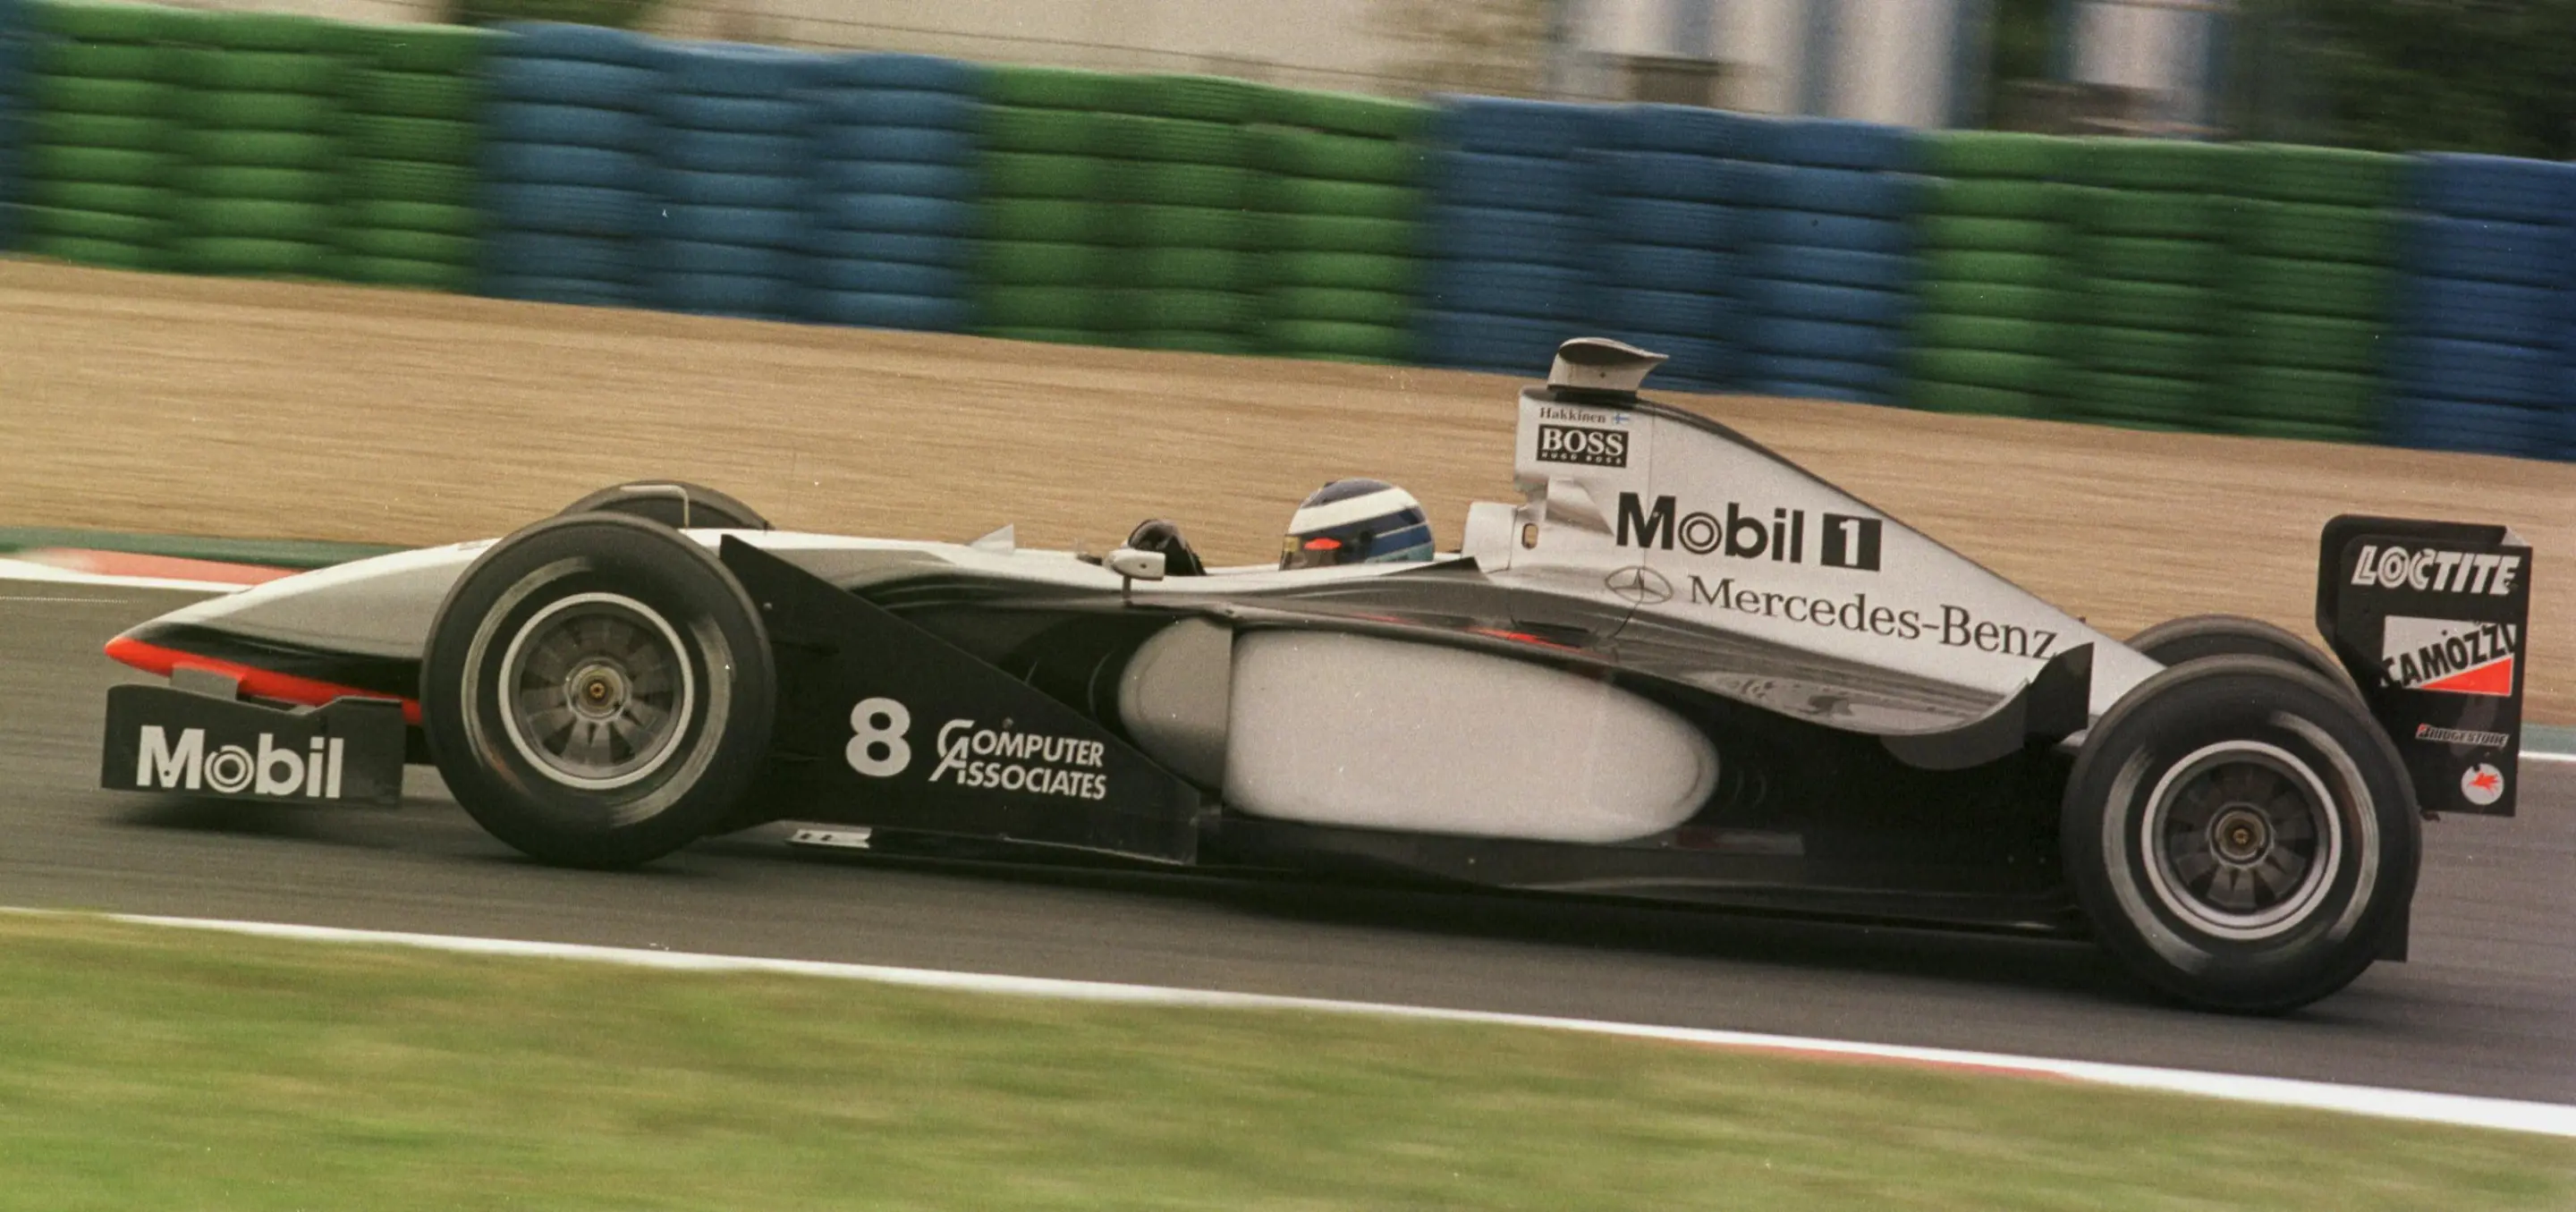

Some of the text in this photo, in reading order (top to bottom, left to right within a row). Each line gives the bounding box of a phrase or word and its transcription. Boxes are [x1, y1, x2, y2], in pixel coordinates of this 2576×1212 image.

[1542, 427, 1623, 456] BOSS
[1615, 492, 1862, 567] Mobil 1
[2351, 545, 2521, 596] LOCTITE
[1687, 574, 2059, 661] Mercedes-Benz
[136, 725, 345, 799] Mobil
[845, 697, 911, 777] 8
[928, 735, 1107, 801] ASSOCIATES
[936, 719, 1106, 768] COMPUTER
